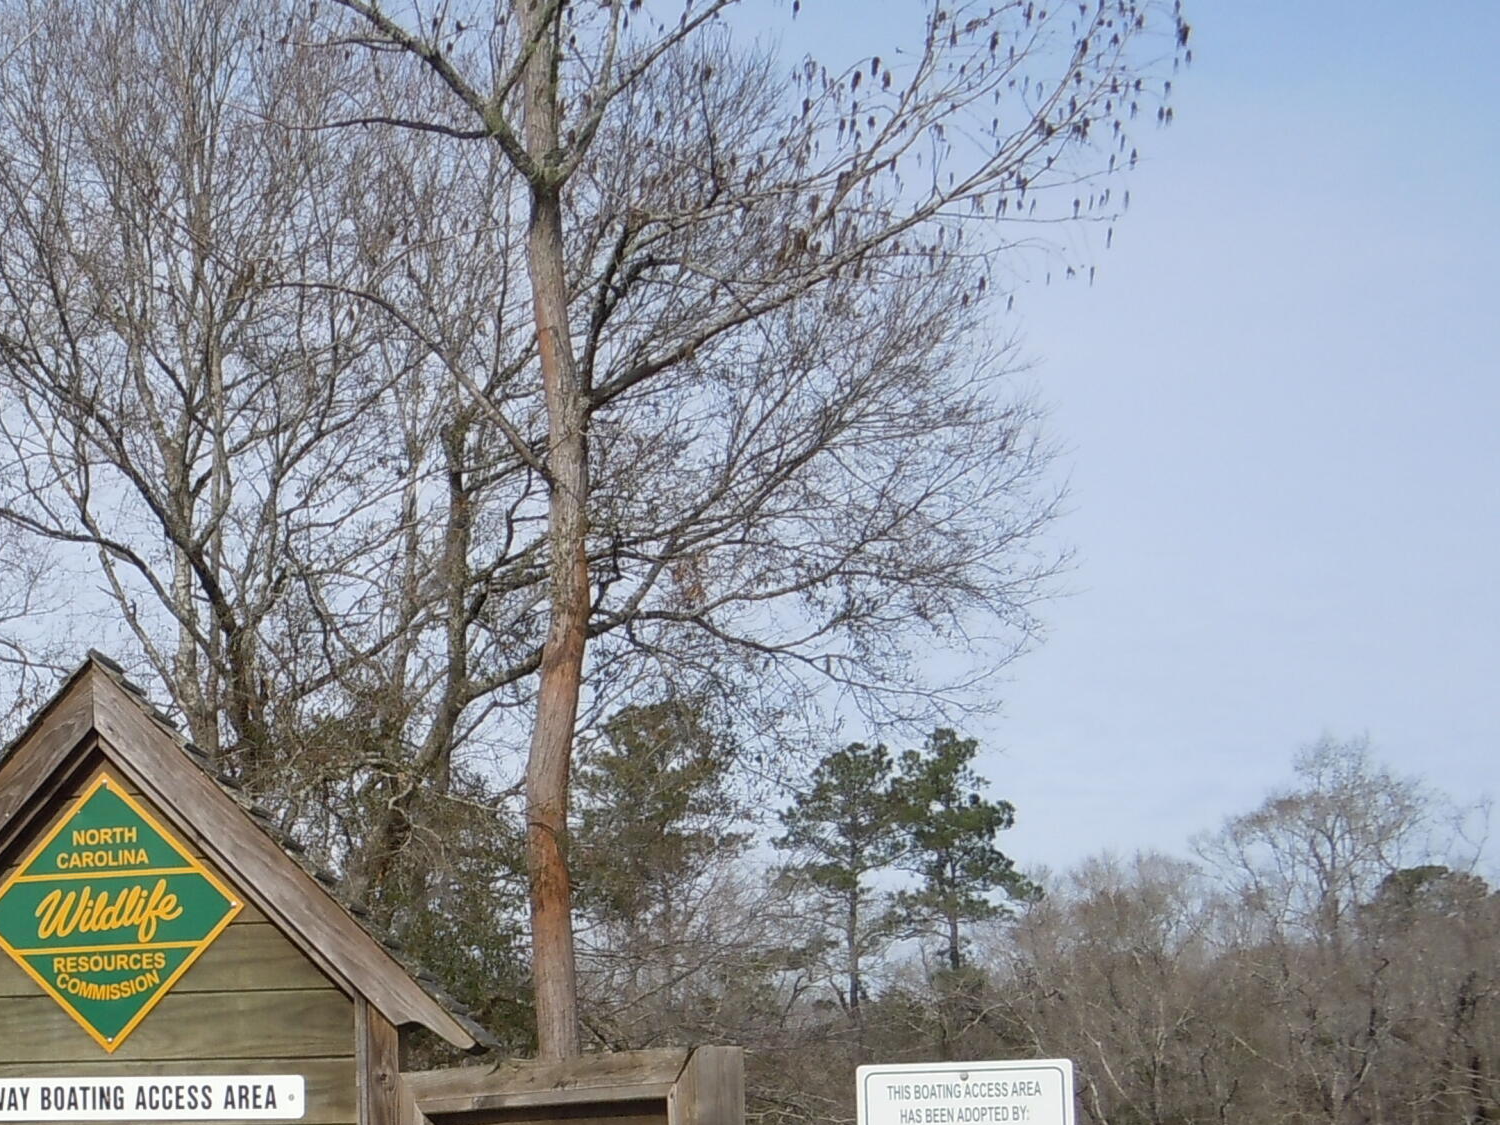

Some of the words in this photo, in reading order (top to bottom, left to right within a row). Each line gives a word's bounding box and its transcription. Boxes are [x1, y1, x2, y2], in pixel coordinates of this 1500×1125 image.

[72, 827, 137, 846] NORTH
[57, 849, 149, 869] CAROLINA
[35, 879, 183, 942] Wildlife
[53, 953, 166, 973] RESOURCES
[56, 970, 160, 1000] COMMISSION
[41, 1086, 124, 1111] BOATING
[135, 1086, 212, 1110] ACCESS
[224, 1085, 277, 1110] AREA
[887, 1085, 911, 1100] THIS
[915, 1084, 961, 1099] BOATING
[964, 1082, 1008, 1098] ACCESS
[1011, 1081, 1042, 1096] AREA
[900, 1109, 922, 1123] HAS
[925, 1108, 954, 1123] BEEN
[958, 1107, 1009, 1122] ADOPTED
[1012, 1106, 1029, 1121] BY:
